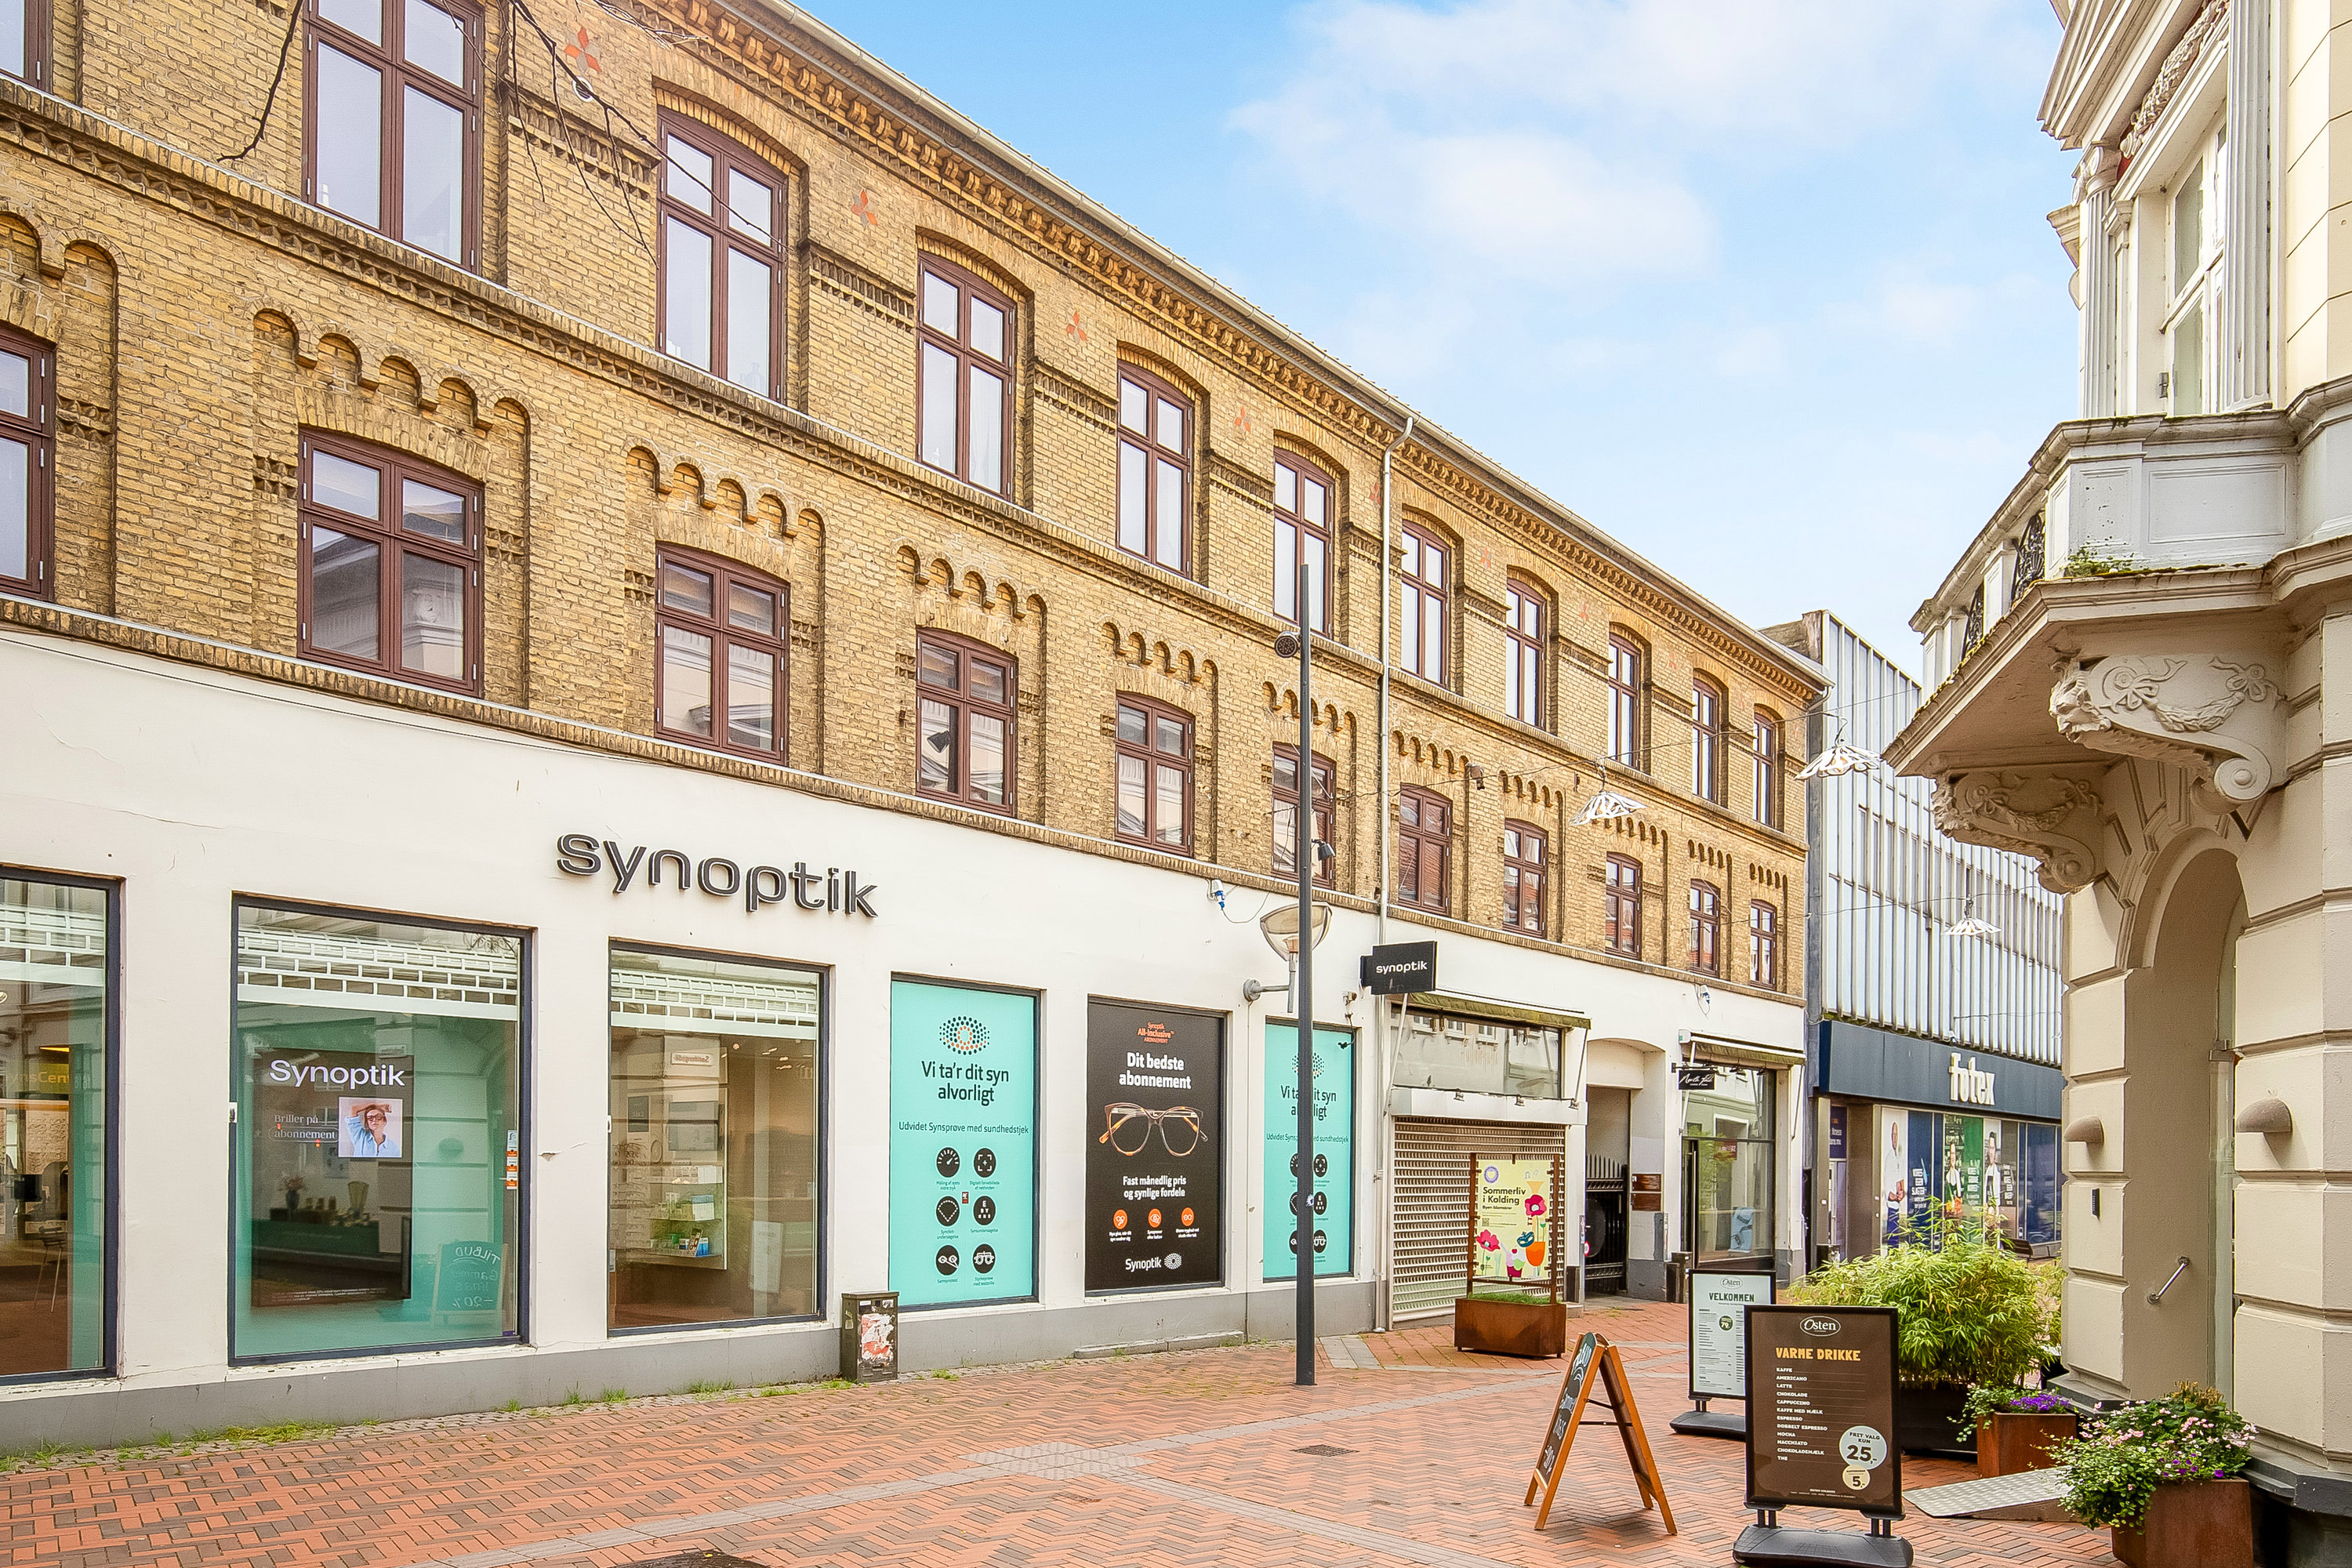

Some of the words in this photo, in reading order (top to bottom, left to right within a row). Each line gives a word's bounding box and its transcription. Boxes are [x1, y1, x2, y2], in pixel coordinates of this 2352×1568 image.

[556, 833, 879, 918] synoptik
[1376, 960, 1427, 975] synoptik
[1127, 1052, 1145, 1068] Dit
[1146, 1053, 1185, 1070] bedste
[270, 1059, 405, 1089] Synoptik
[921, 1061, 935, 1077] Vi
[965, 1063, 983, 1080] dit
[986, 1069, 1009, 1086] syn
[1119, 1069, 1192, 1089] abonnement
[938, 1083, 994, 1106] alvorligt
[1280, 1085, 1290, 1098] Vi
[1321, 1092, 1337, 1105] syn
[274, 1114, 304, 1123] Briller
[307, 1115, 318, 1126] på
[274, 1128, 336, 1139] abonnement
[898, 1121, 927, 1131] Udvidet
[929, 1123, 965, 1134] Synsprøve
[967, 1124, 982, 1133] med
[984, 1124, 1029, 1136] sundhedstjek
[1123, 1176, 1138, 1185] Fast
[1139, 1175, 1172, 1187] månedlig
[1173, 1175, 1187, 1187] pris
[1123, 1190, 1134, 1200] og
[1134, 1188, 1160, 1200] synlige
[1160, 1187, 1185, 1197] fordele
[1488, 1196, 1519, 1206] Kolding
[1125, 1257, 1162, 1272] Synoptik
[1709, 1292, 1755, 1302] VELKOMMEN
[1804, 1319, 1836, 1330] Osten
[1775, 1347, 1813, 1359] VARME
[1817, 1348, 1861, 1361] DRIKKE
